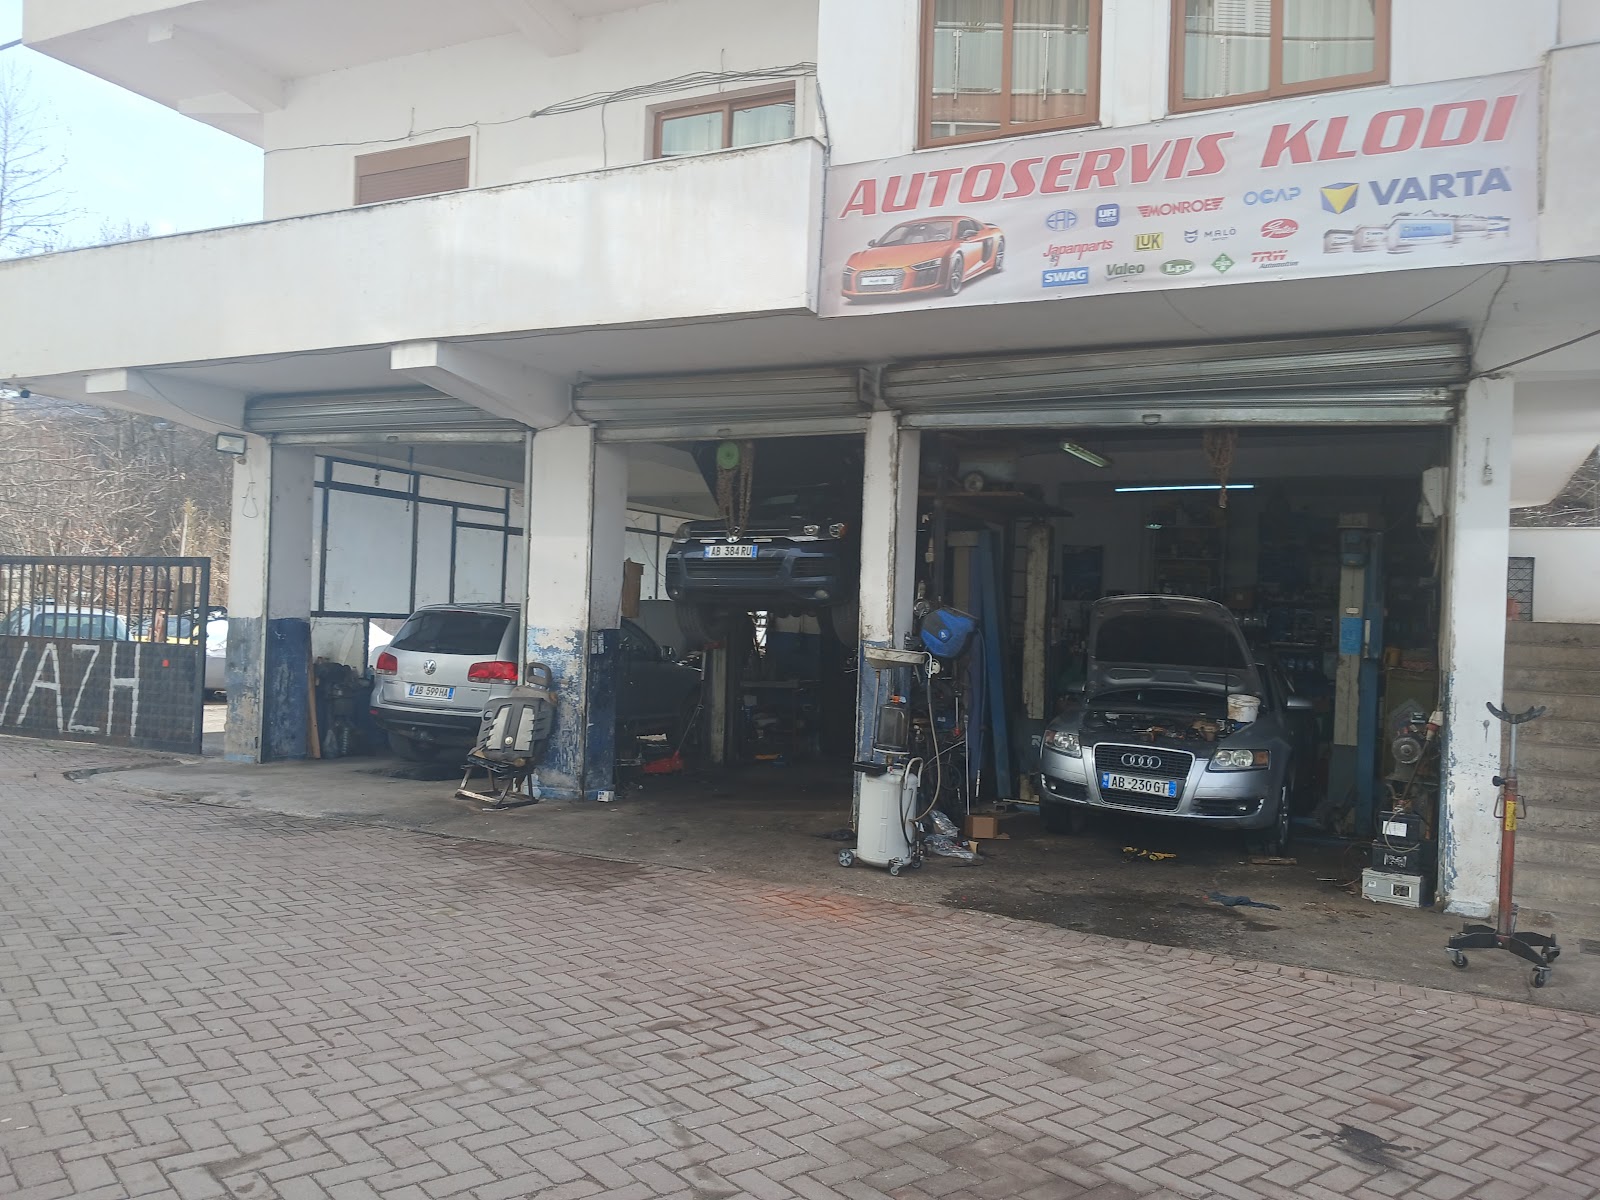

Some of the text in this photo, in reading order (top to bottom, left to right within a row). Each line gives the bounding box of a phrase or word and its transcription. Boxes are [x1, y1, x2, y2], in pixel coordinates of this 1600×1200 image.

[839, 95, 1519, 219] AUTOSERVIS KLODI
[1243, 186, 1301, 206] OCAP
[1368, 167, 1512, 206] VARTA
[1137, 197, 1225, 217] MONROE
[1043, 240, 1114, 266] Japanparts
[1044, 269, 1088, 283] SWAG
[1106, 262, 1145, 276] Valeo
